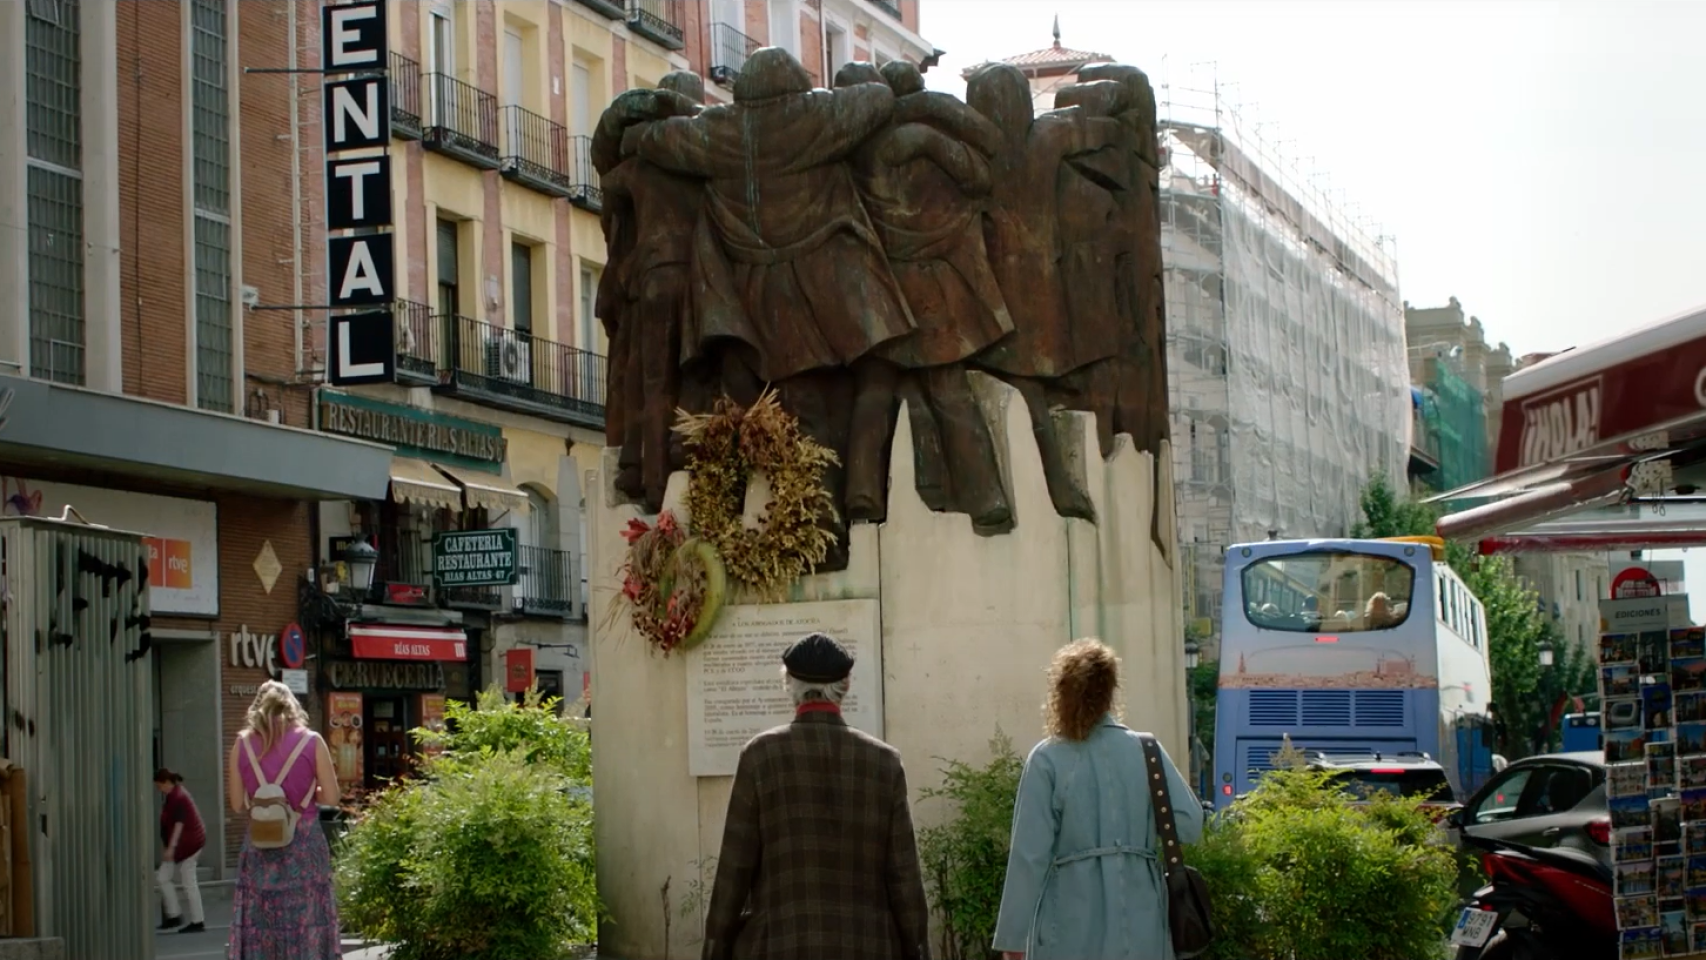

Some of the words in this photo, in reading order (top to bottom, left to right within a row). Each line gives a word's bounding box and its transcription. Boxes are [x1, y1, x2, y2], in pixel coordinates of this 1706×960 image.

[328, 402, 424, 447] RESTAURANTE
[428, 423, 457, 454] RIAS
[1524, 387, 1599, 466] ¡HOLA!
[444, 534, 504, 553] CAFETERIA
[168, 555, 188, 574] rtve
[437, 551, 512, 571] RESTAURANTE
[466, 570, 492, 581] ALTAS
[1614, 607, 1661, 619] EDICIONES
[230, 624, 276, 677] rtve
[330, 661, 446, 690] CERVECERIA
